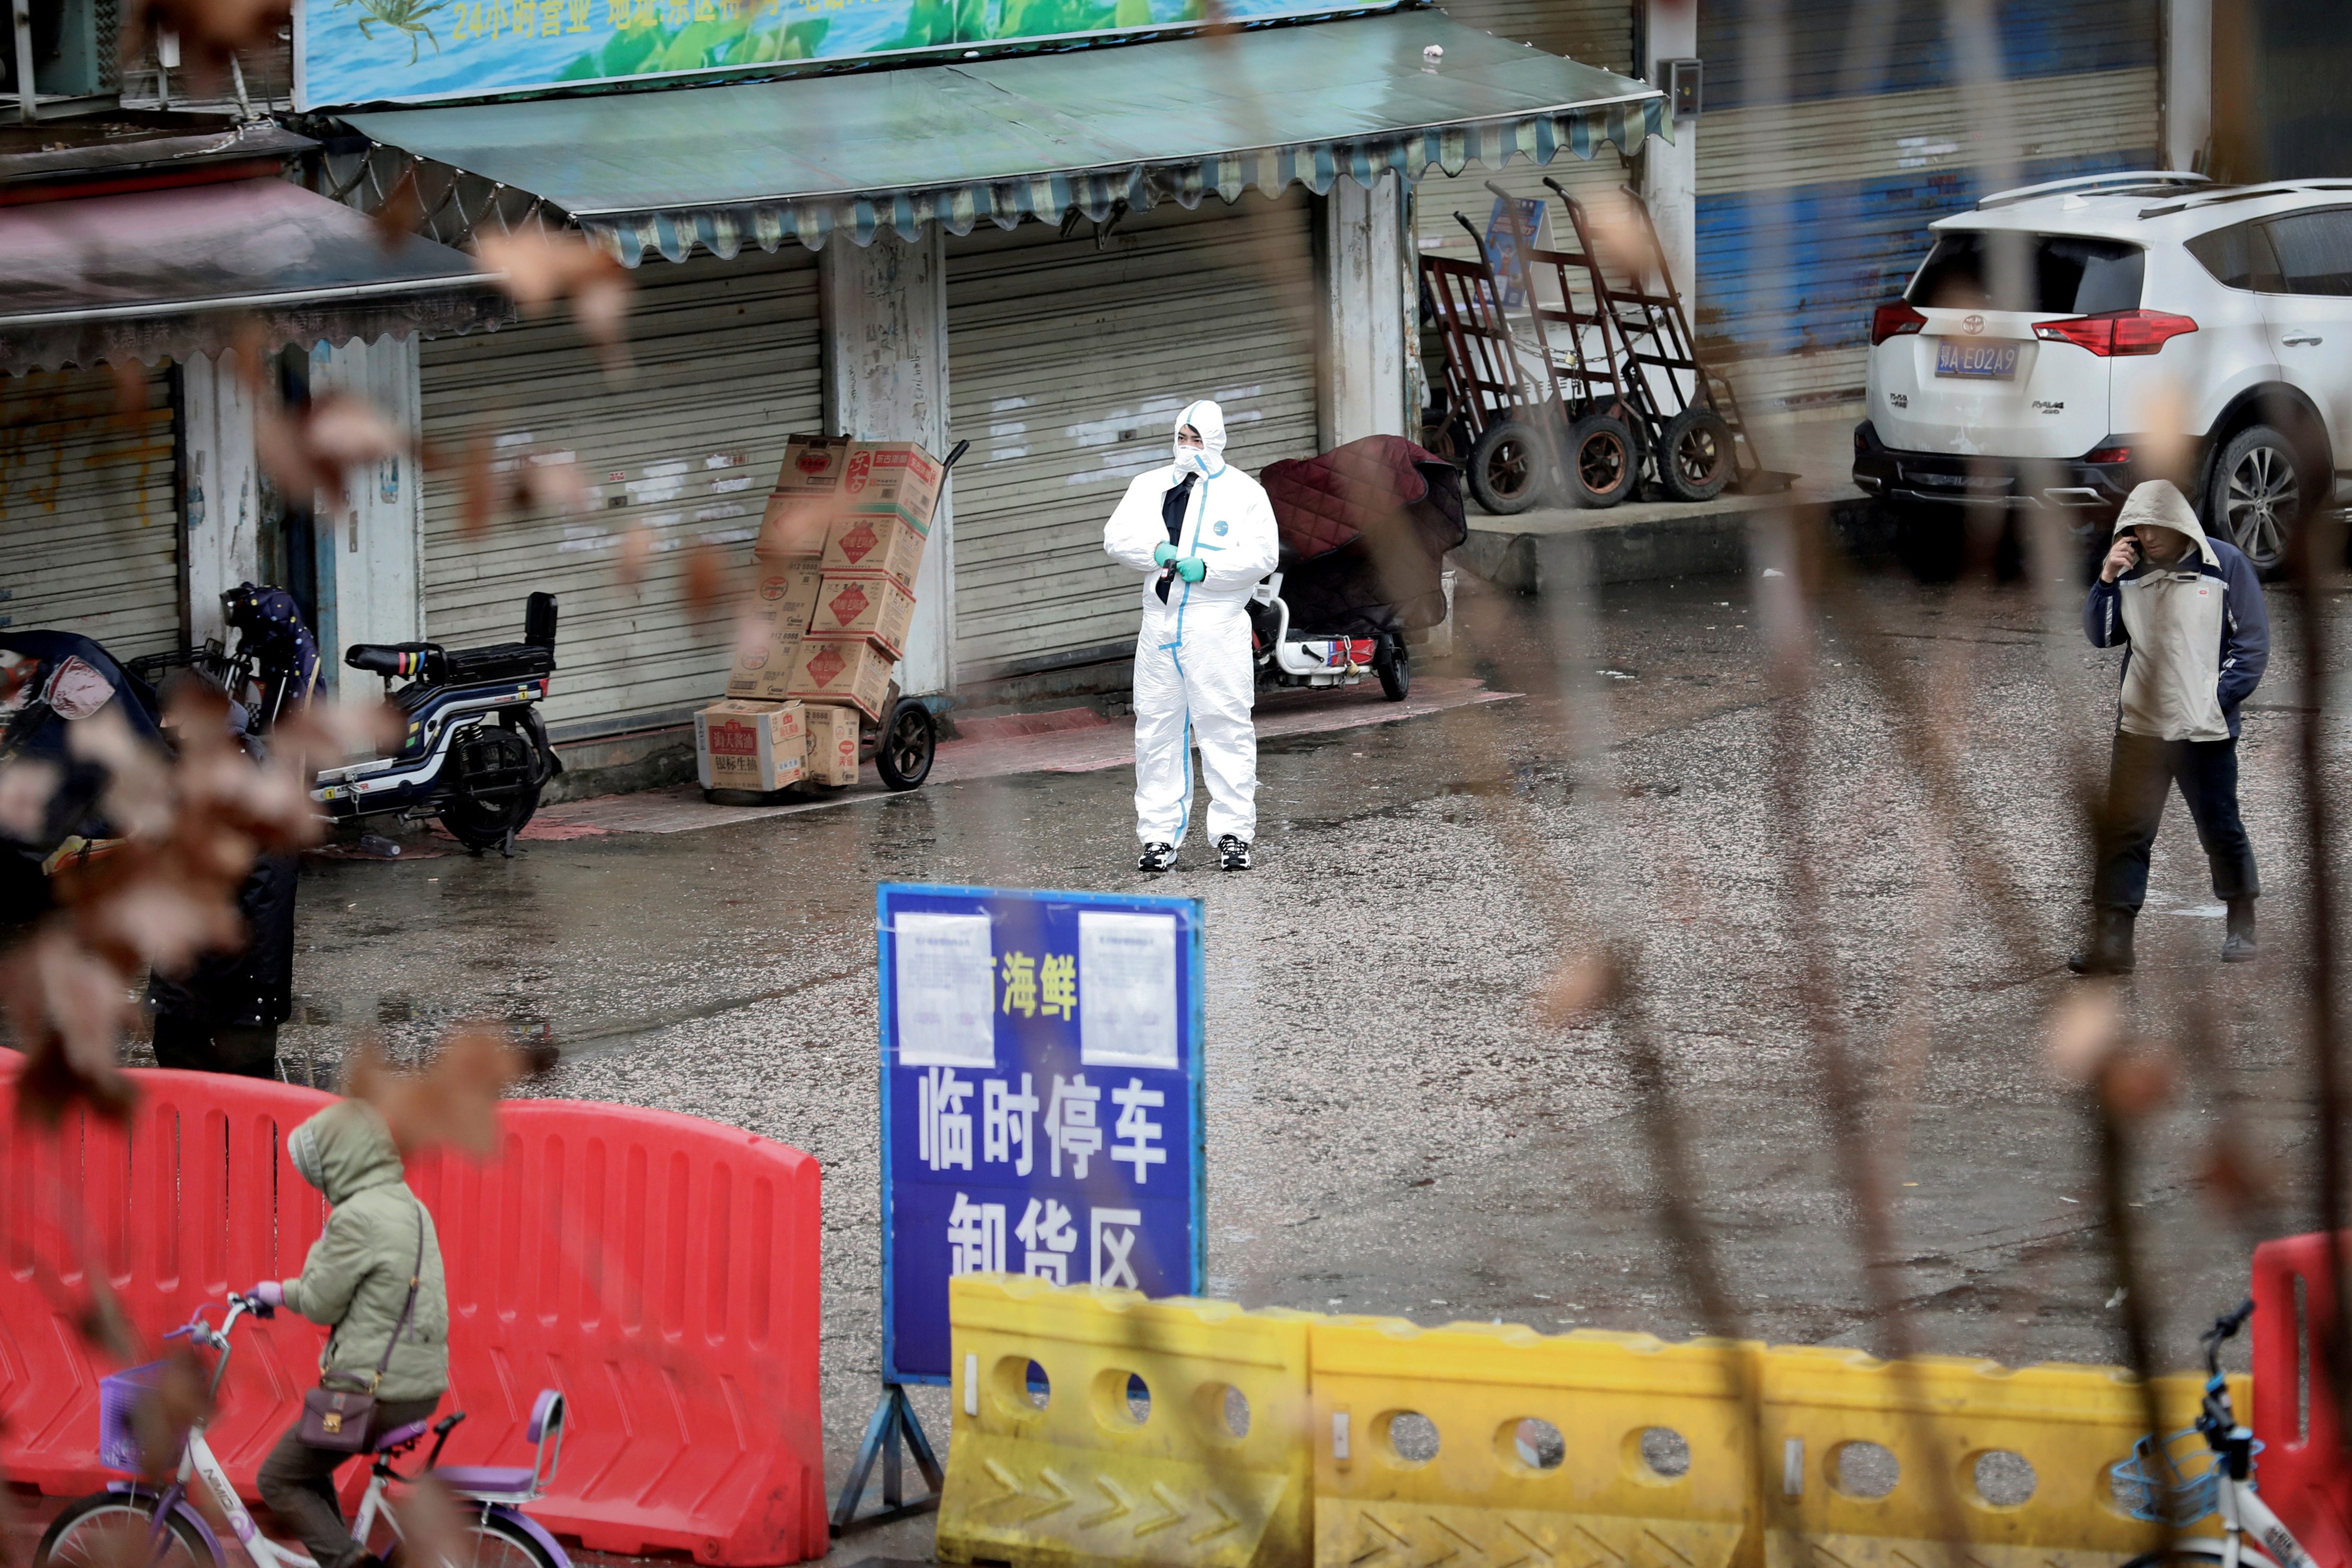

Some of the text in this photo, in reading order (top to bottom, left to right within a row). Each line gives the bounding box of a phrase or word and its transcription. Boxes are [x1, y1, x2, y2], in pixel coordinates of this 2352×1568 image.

[453, 0, 590, 40] 24小时营业
[991, 950, 1077, 1021] 海鲜
[918, 1066, 1167, 1184] 临时停车
[947, 1192, 1142, 1289] 卸货区
